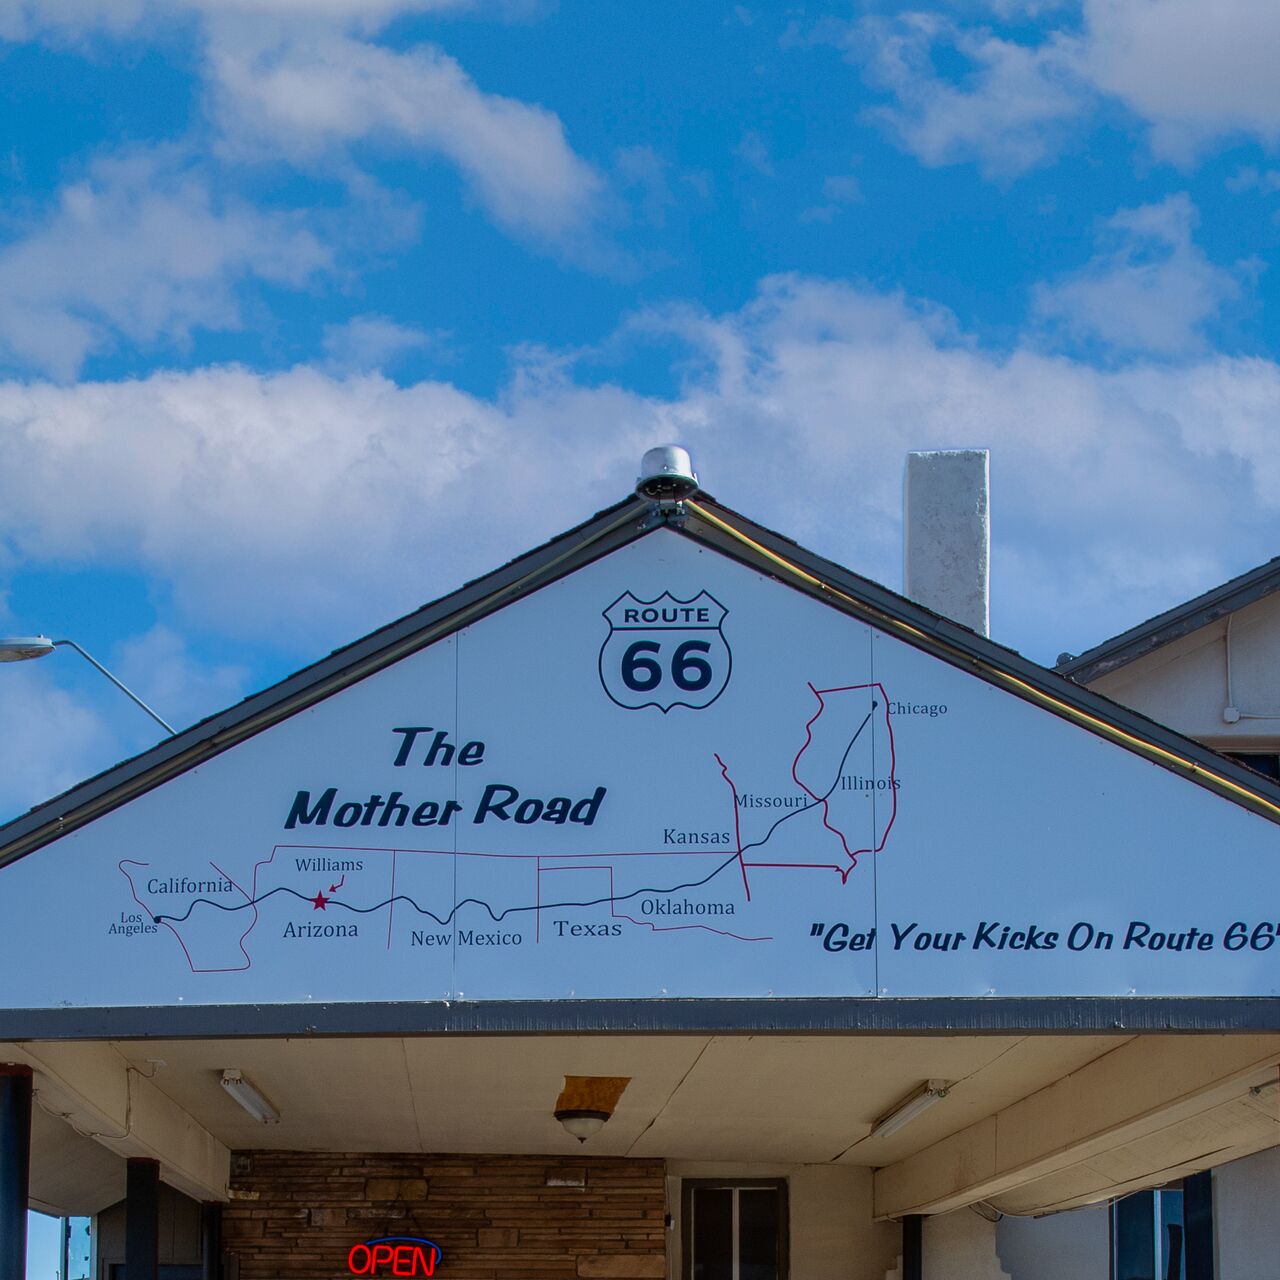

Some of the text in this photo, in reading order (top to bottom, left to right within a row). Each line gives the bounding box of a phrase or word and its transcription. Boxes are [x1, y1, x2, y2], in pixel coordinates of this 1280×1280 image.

[625, 608, 709, 622] ROUTE
[622, 640, 712, 691] 66
[887, 700, 948, 717] Chicago
[392, 727, 485, 766] The
[841, 775, 901, 791] Illinois
[283, 784, 607, 829] Mother Road
[735, 793, 807, 808] Missouri
[664, 829, 729, 844] Kansas
[296, 858, 363, 872] Williams
[148, 877, 233, 894] California
[642, 899, 735, 914] Oklahoma
[121, 912, 142, 923] Los
[109, 922, 157, 936] Angeles
[283, 922, 358, 937] Arizona
[553, 921, 621, 936] Texas
[412, 930, 522, 946] New Mexico
[810, 923, 876, 952] "Get
[891, 923, 967, 951] Your
[973, 922, 1059, 950] Kicks
[1067, 922, 1113, 951] On
[1123, 921, 1214, 951] Route
[348, 1244, 435, 1276] OPEN
